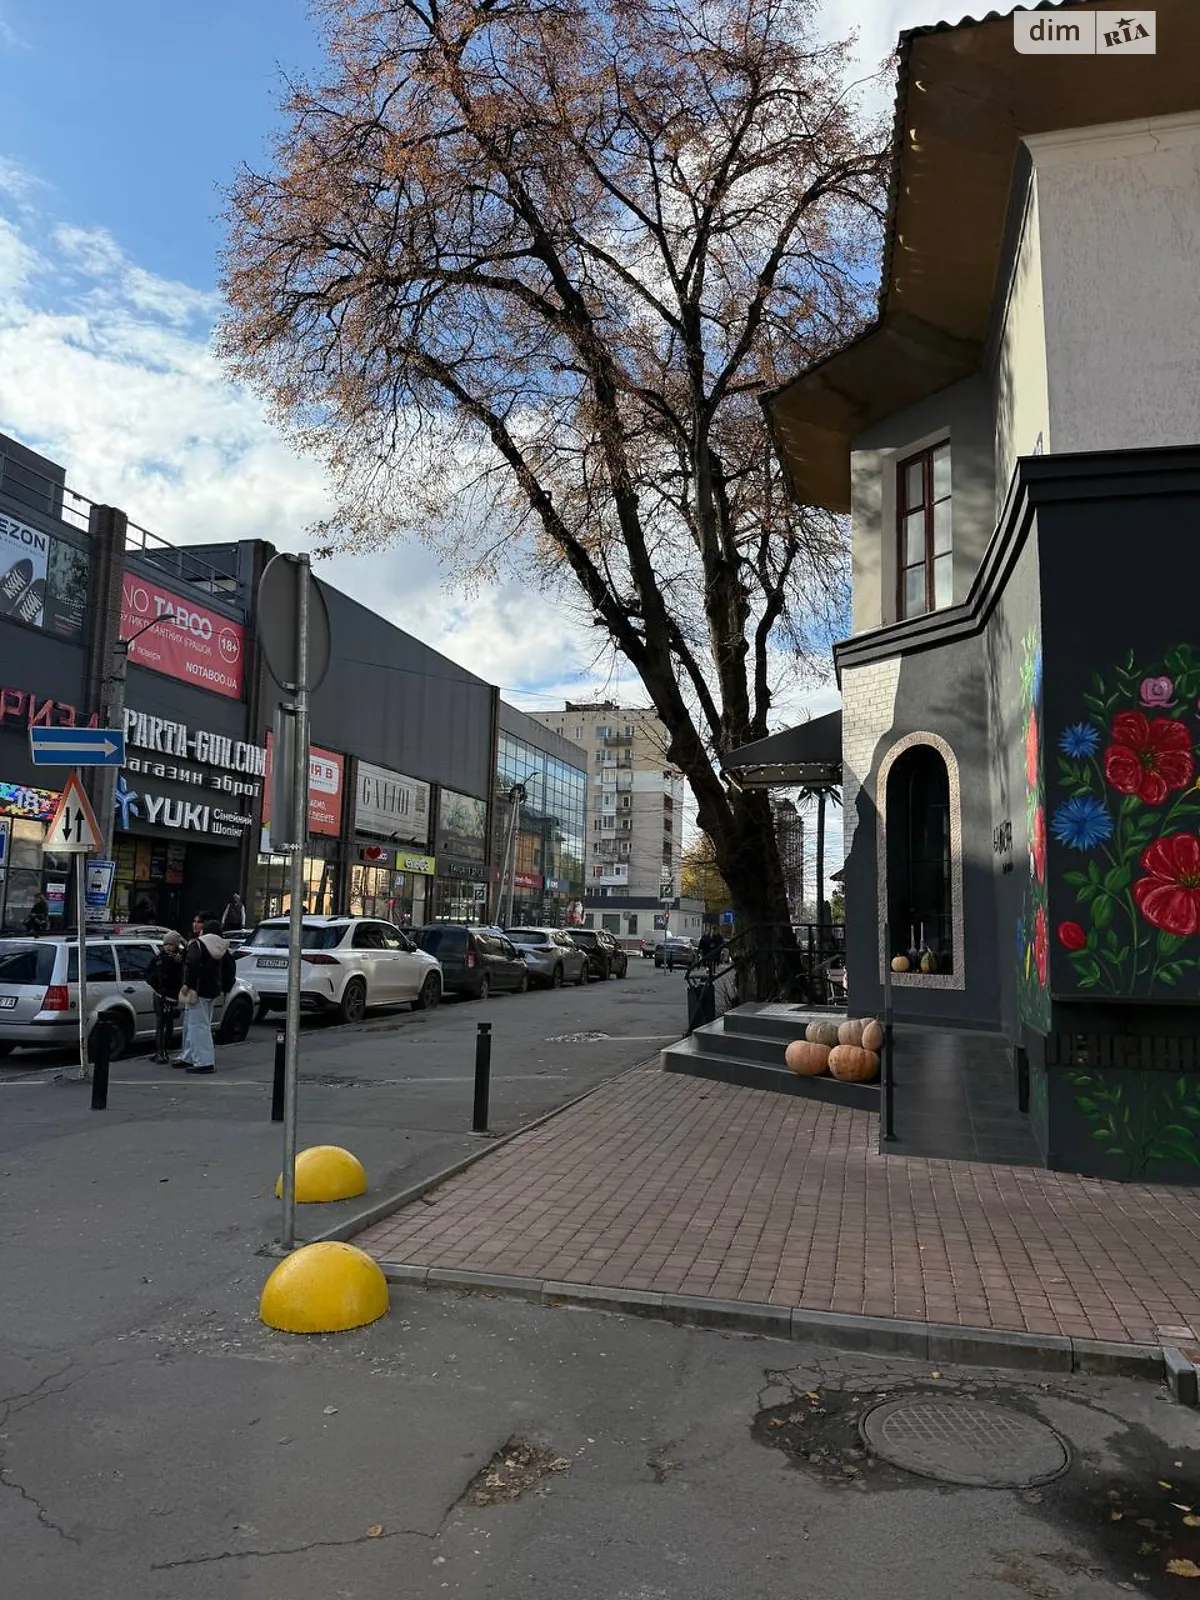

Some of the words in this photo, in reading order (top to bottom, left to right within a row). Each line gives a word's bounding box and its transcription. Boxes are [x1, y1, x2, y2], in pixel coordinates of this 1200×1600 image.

[122, 583, 150, 613] NO
[153, 594, 213, 641] TABOO
[220, 638, 238, 653] 18+
[185, 661, 238, 690] NOTABOO.UA
[123, 707, 268, 777] PARTA-GUN.COM
[122, 757, 203, 785] агазин
[210, 774, 260, 798] зброї
[144, 793, 211, 833] YUKI
